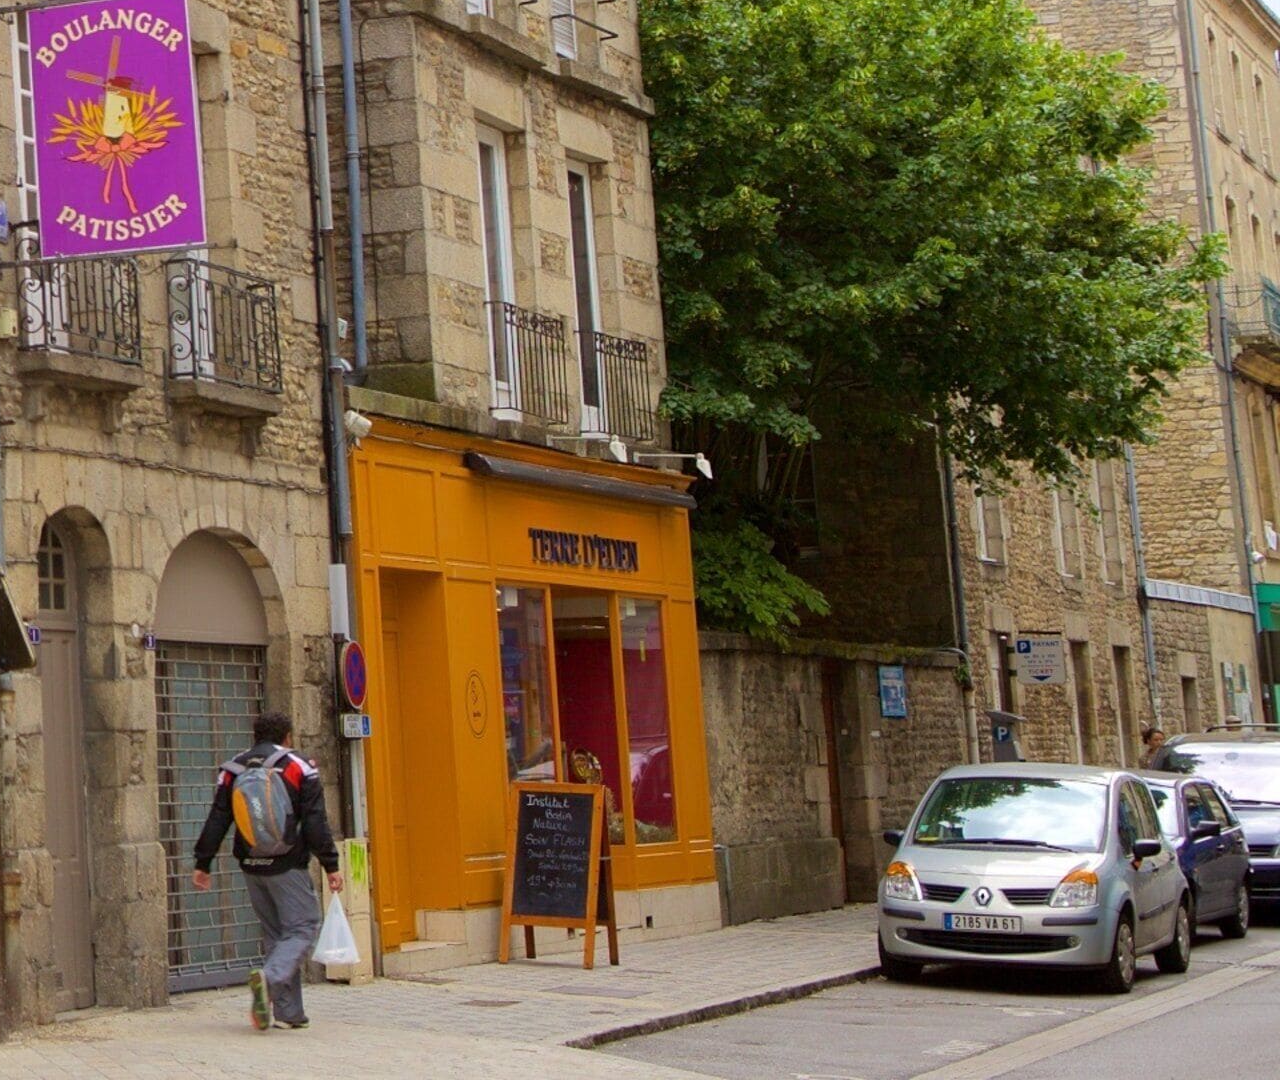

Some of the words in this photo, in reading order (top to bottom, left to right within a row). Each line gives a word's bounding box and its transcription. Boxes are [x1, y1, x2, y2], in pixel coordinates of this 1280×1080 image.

[35, 8, 184, 68] BOULANGER
[56, 193, 188, 242] PATISSIER
[528, 527, 580, 565] TERRE
[581, 533, 639, 572] D'EDEN
[998, 726, 1008, 741] P
[526, 794, 570, 809] Institut
[954, 916, 981, 929] 2185
[984, 918, 999, 929] VA
[1002, 918, 1016, 930] 61
